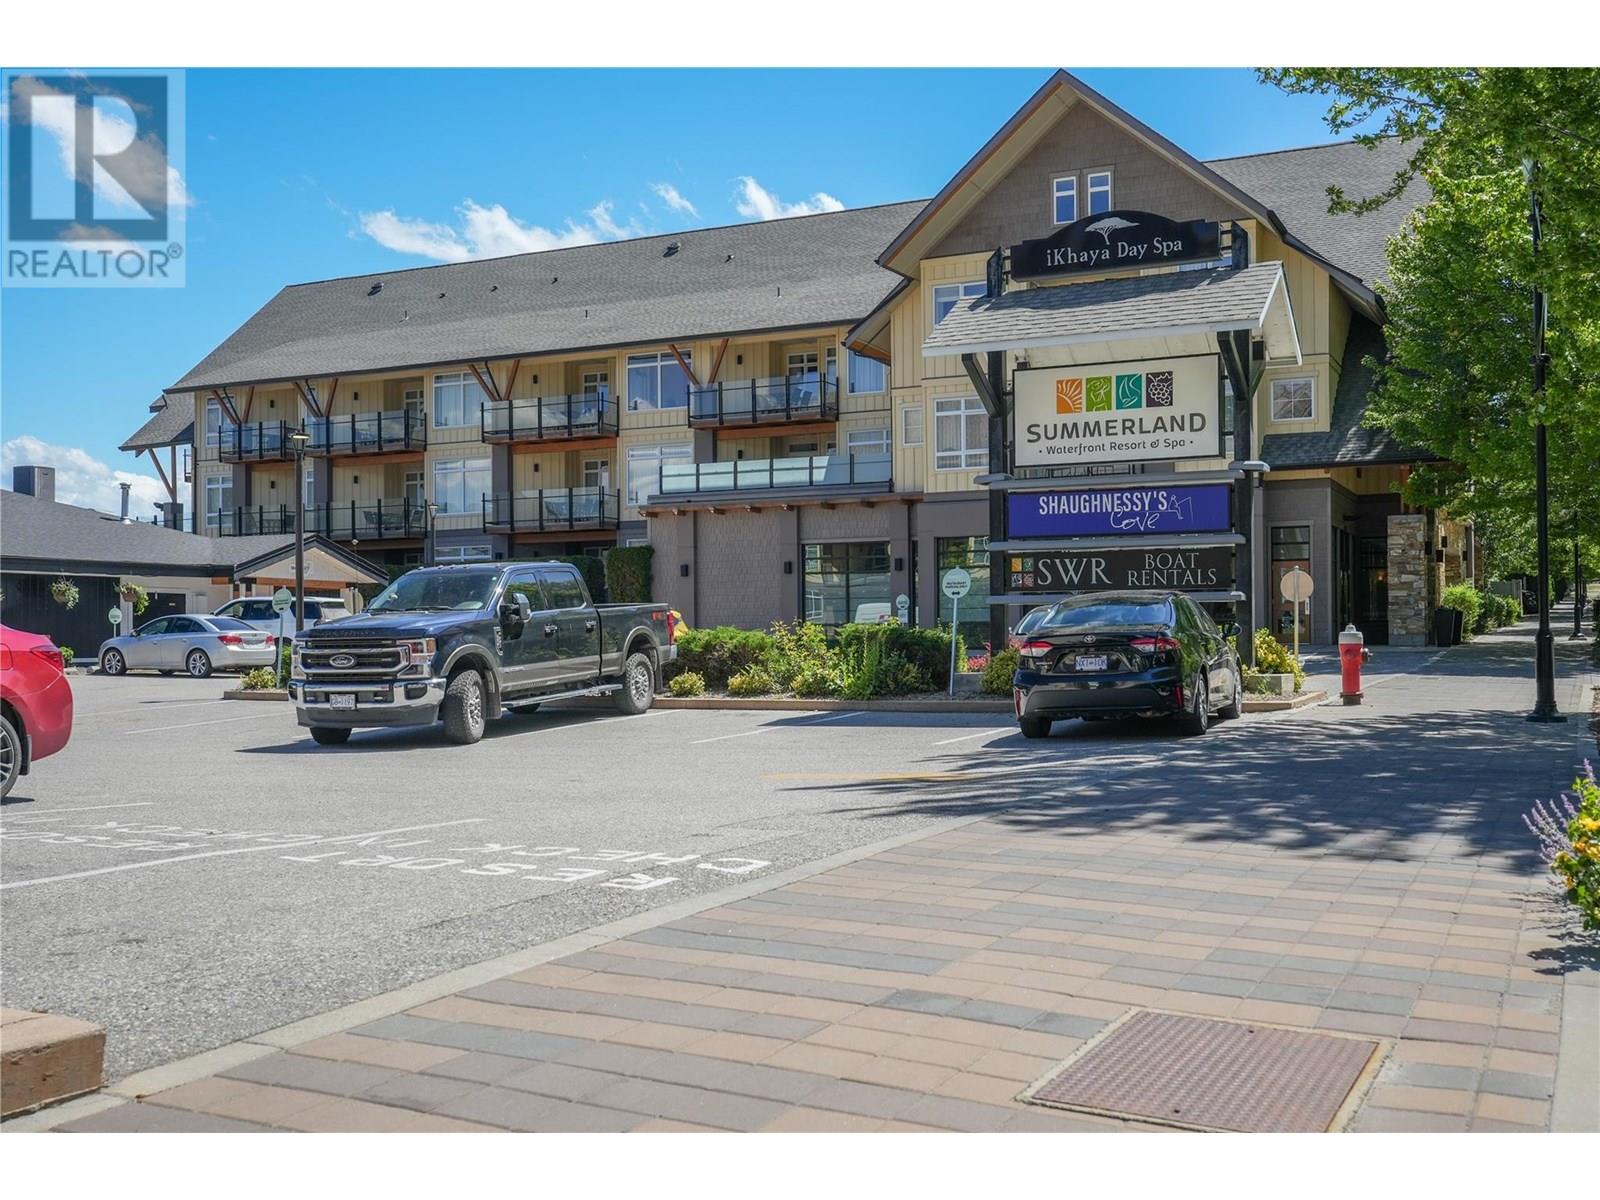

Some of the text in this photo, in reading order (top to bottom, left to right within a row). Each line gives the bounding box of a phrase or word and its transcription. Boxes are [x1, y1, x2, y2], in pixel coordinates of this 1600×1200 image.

[1046, 237, 1183, 267] iKhaya Day Spa
[1026, 412, 1207, 444] SUMMERLAND
[1046, 443, 1106, 456] Waterfront
[1109, 439, 1147, 452] Resort
[1163, 438, 1186, 450] Spa
[1039, 490, 1168, 516] SHAUGHNESSY'S
[1110, 506, 1160, 531] Cove
[1037, 557, 1113, 586] SWR
[1144, 552, 1200, 569] BOAT
[1127, 568, 1217, 587] RENTALS
[279, 851, 680, 891] RESORT
[447, 843, 771, 875] CHECK
